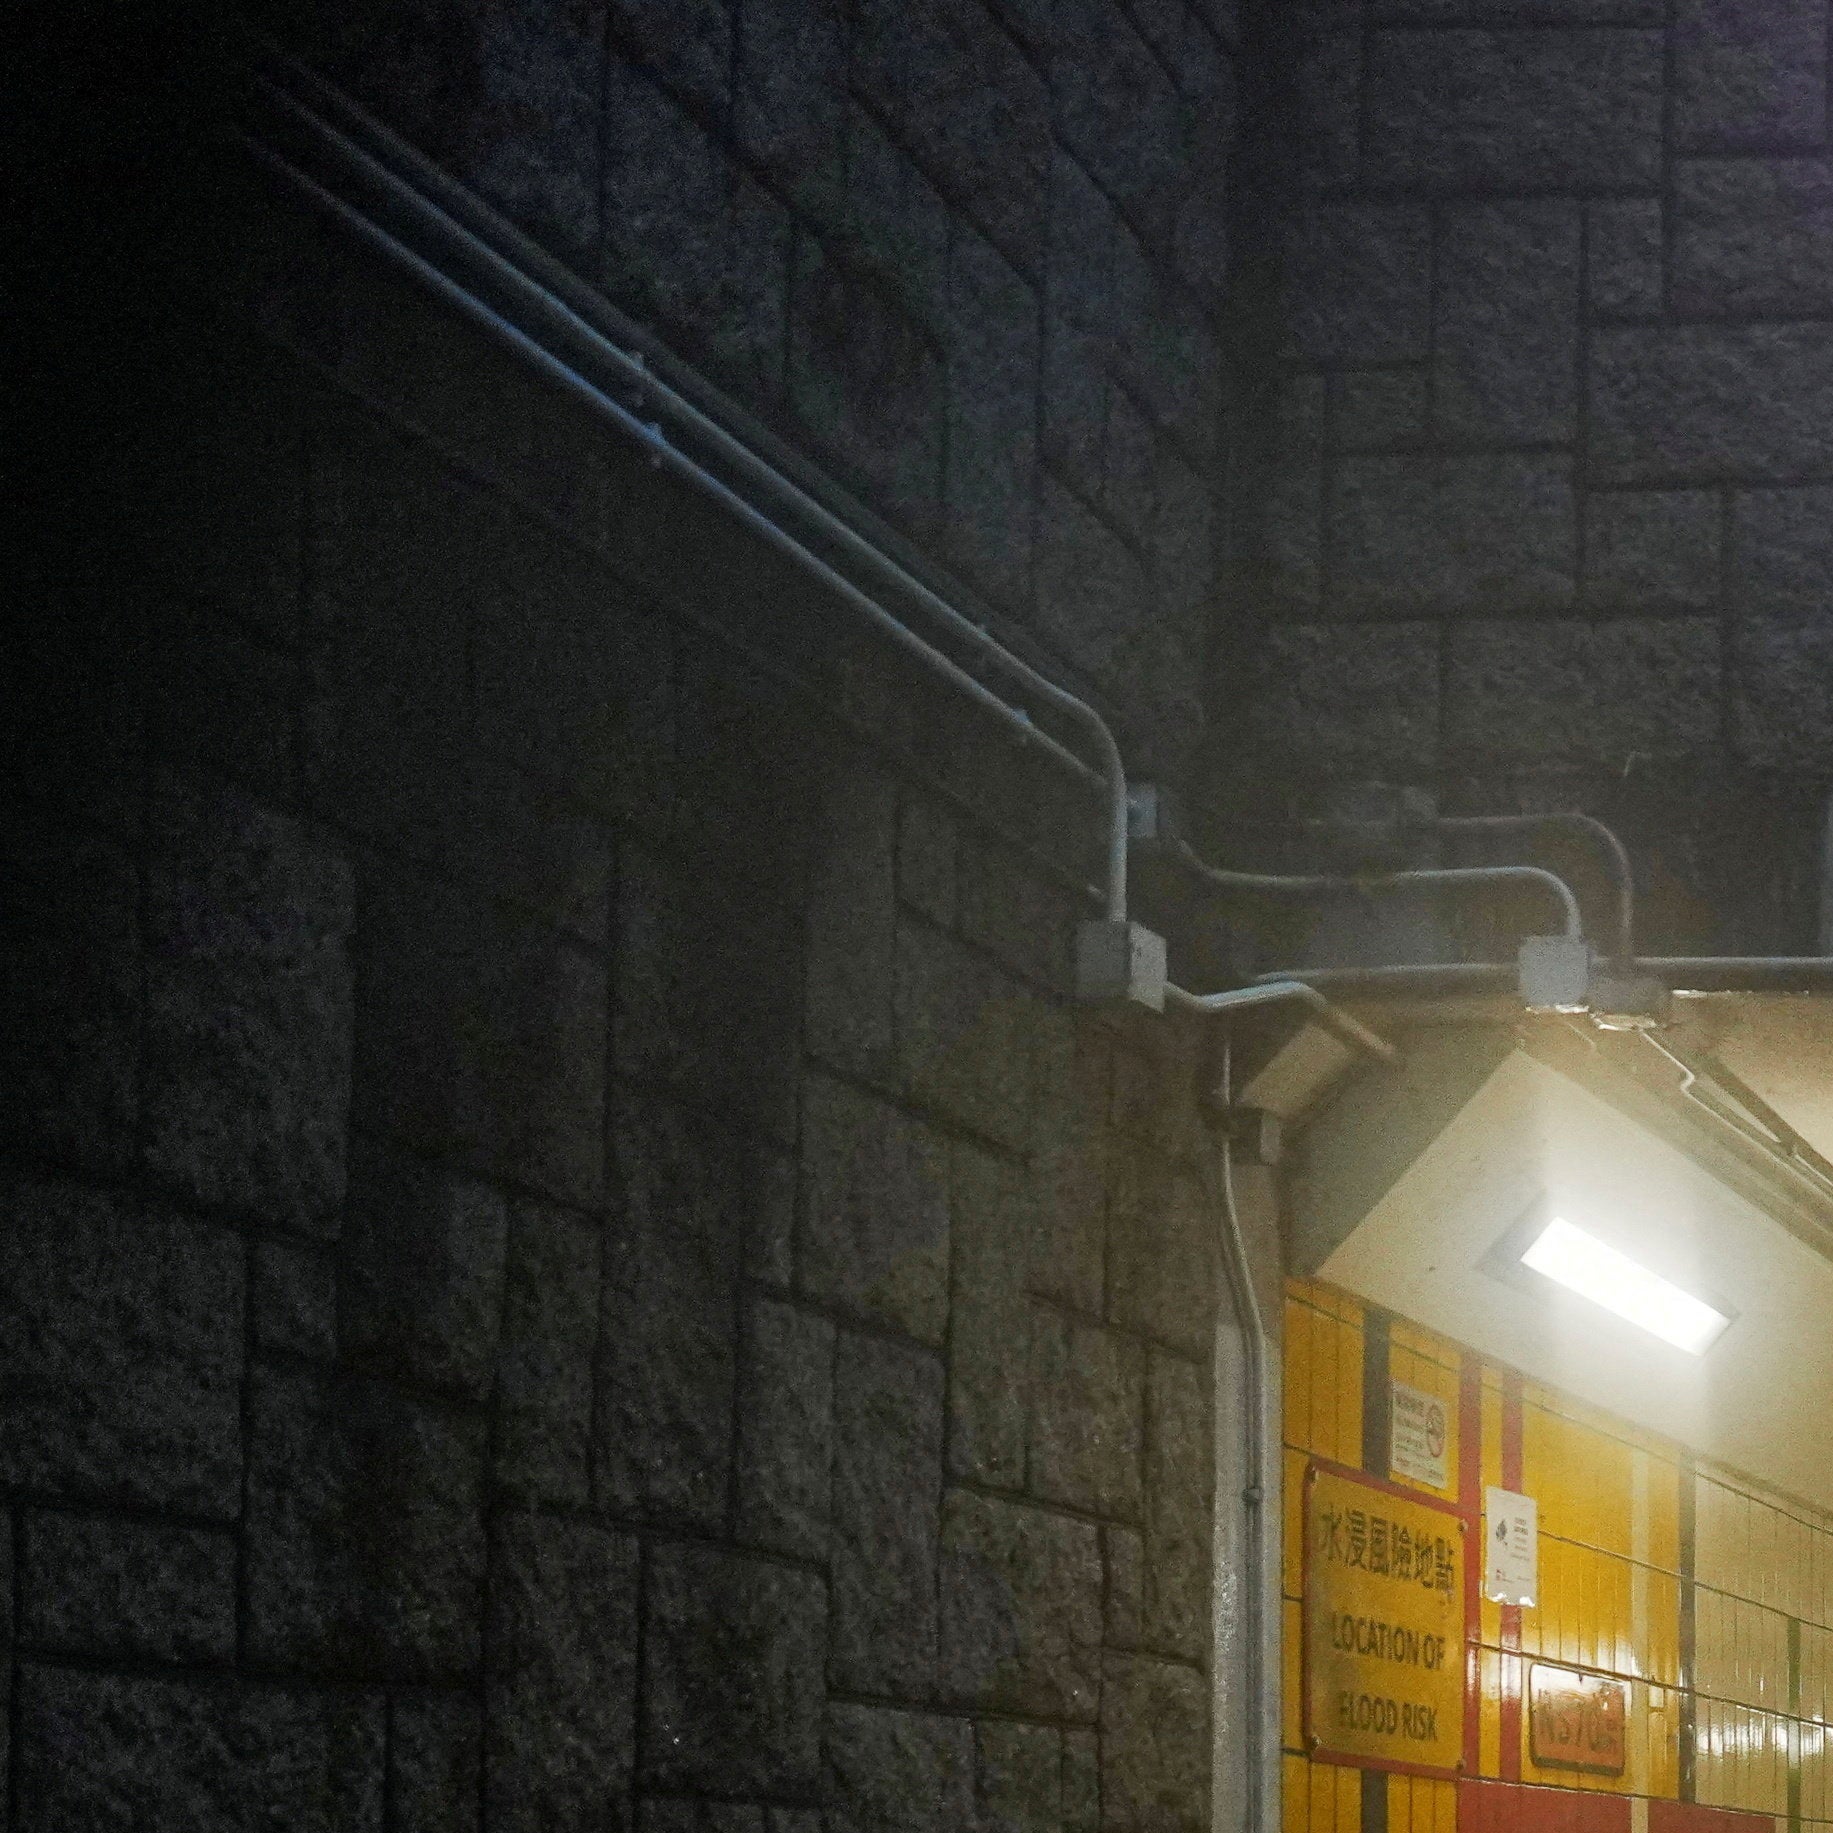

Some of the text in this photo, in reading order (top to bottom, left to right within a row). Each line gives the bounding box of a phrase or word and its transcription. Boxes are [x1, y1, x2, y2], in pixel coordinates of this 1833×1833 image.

[1332, 1613, 1445, 1670] LOCATION OF
[1338, 1690, 1438, 1742] FLOOD RISK
